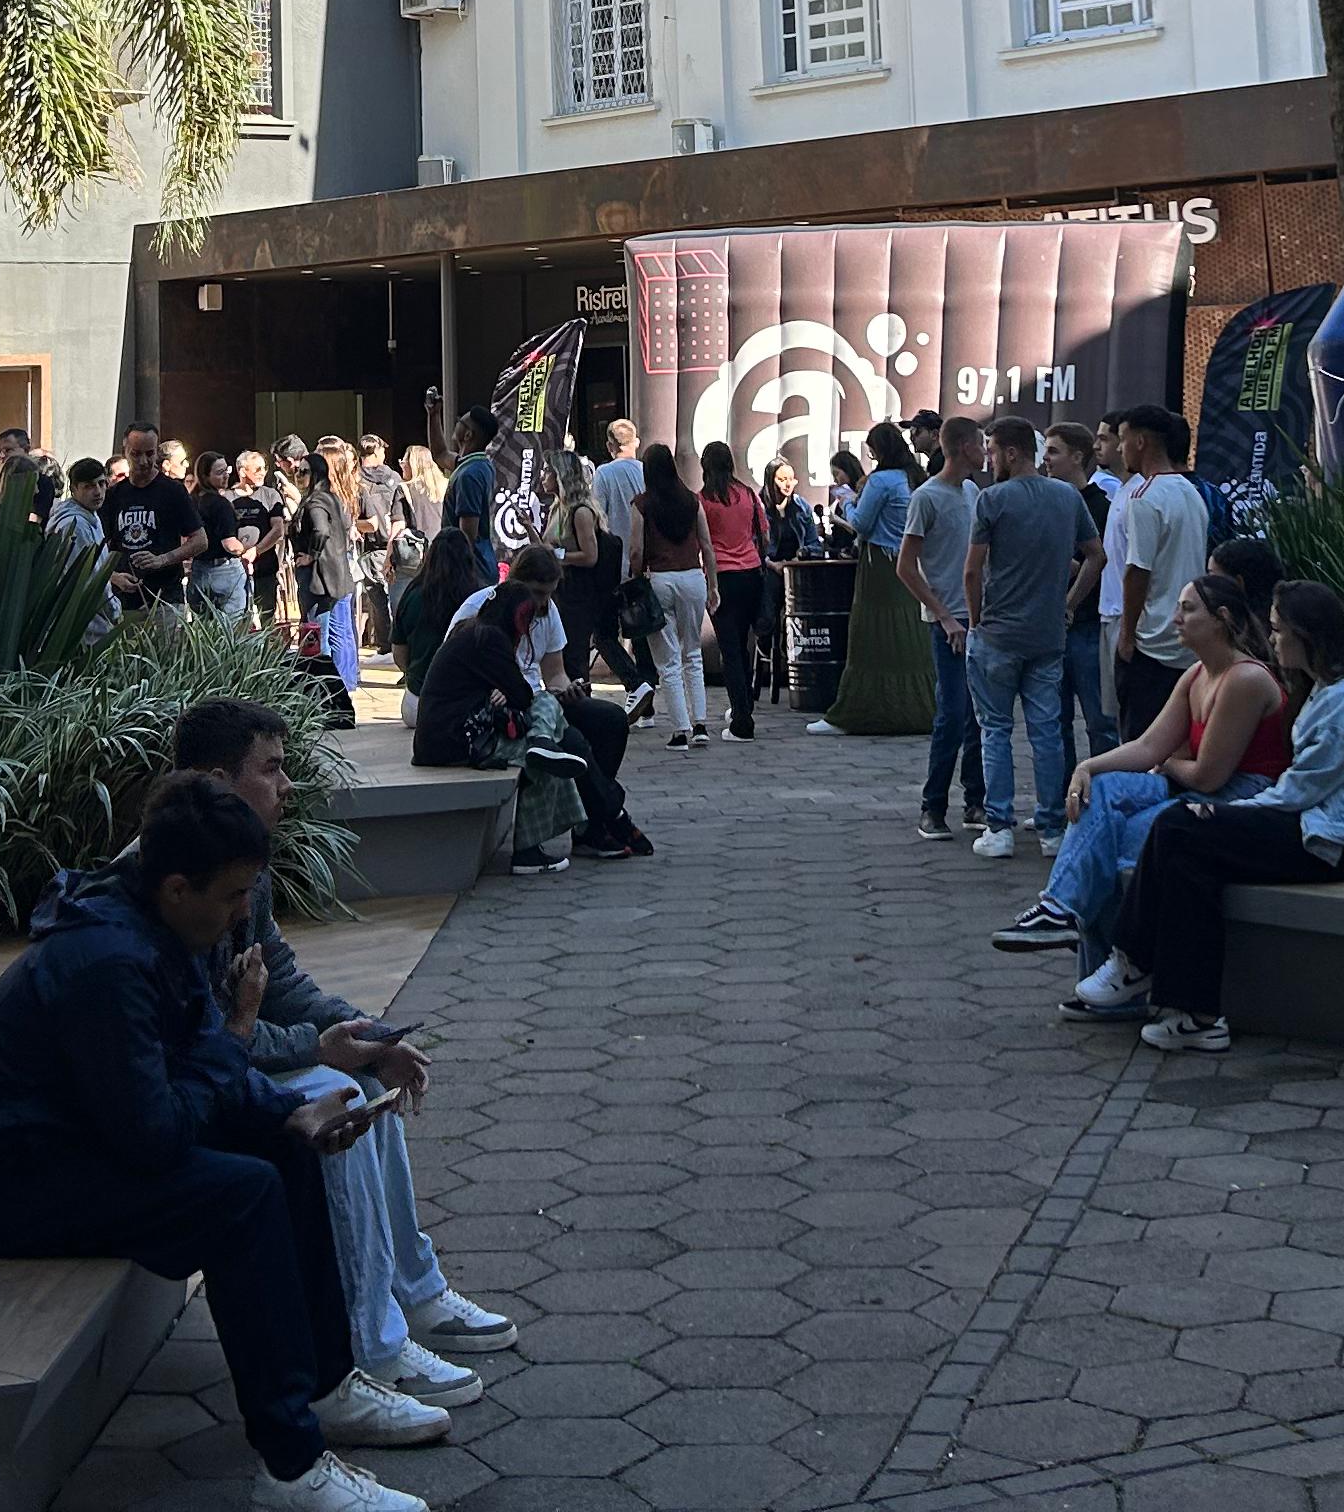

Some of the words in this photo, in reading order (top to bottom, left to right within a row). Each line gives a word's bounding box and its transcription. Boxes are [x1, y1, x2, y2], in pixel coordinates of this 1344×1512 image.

[1267, 325, 1281, 346] FM
[1243, 327, 1267, 393] MELHOR
[1262, 350, 1274, 370] DO
[957, 365, 1021, 406] 97.1
[1035, 364, 1076, 404] FM
[1256, 373, 1270, 408] VIBE
[1240, 397, 1252, 408] A
